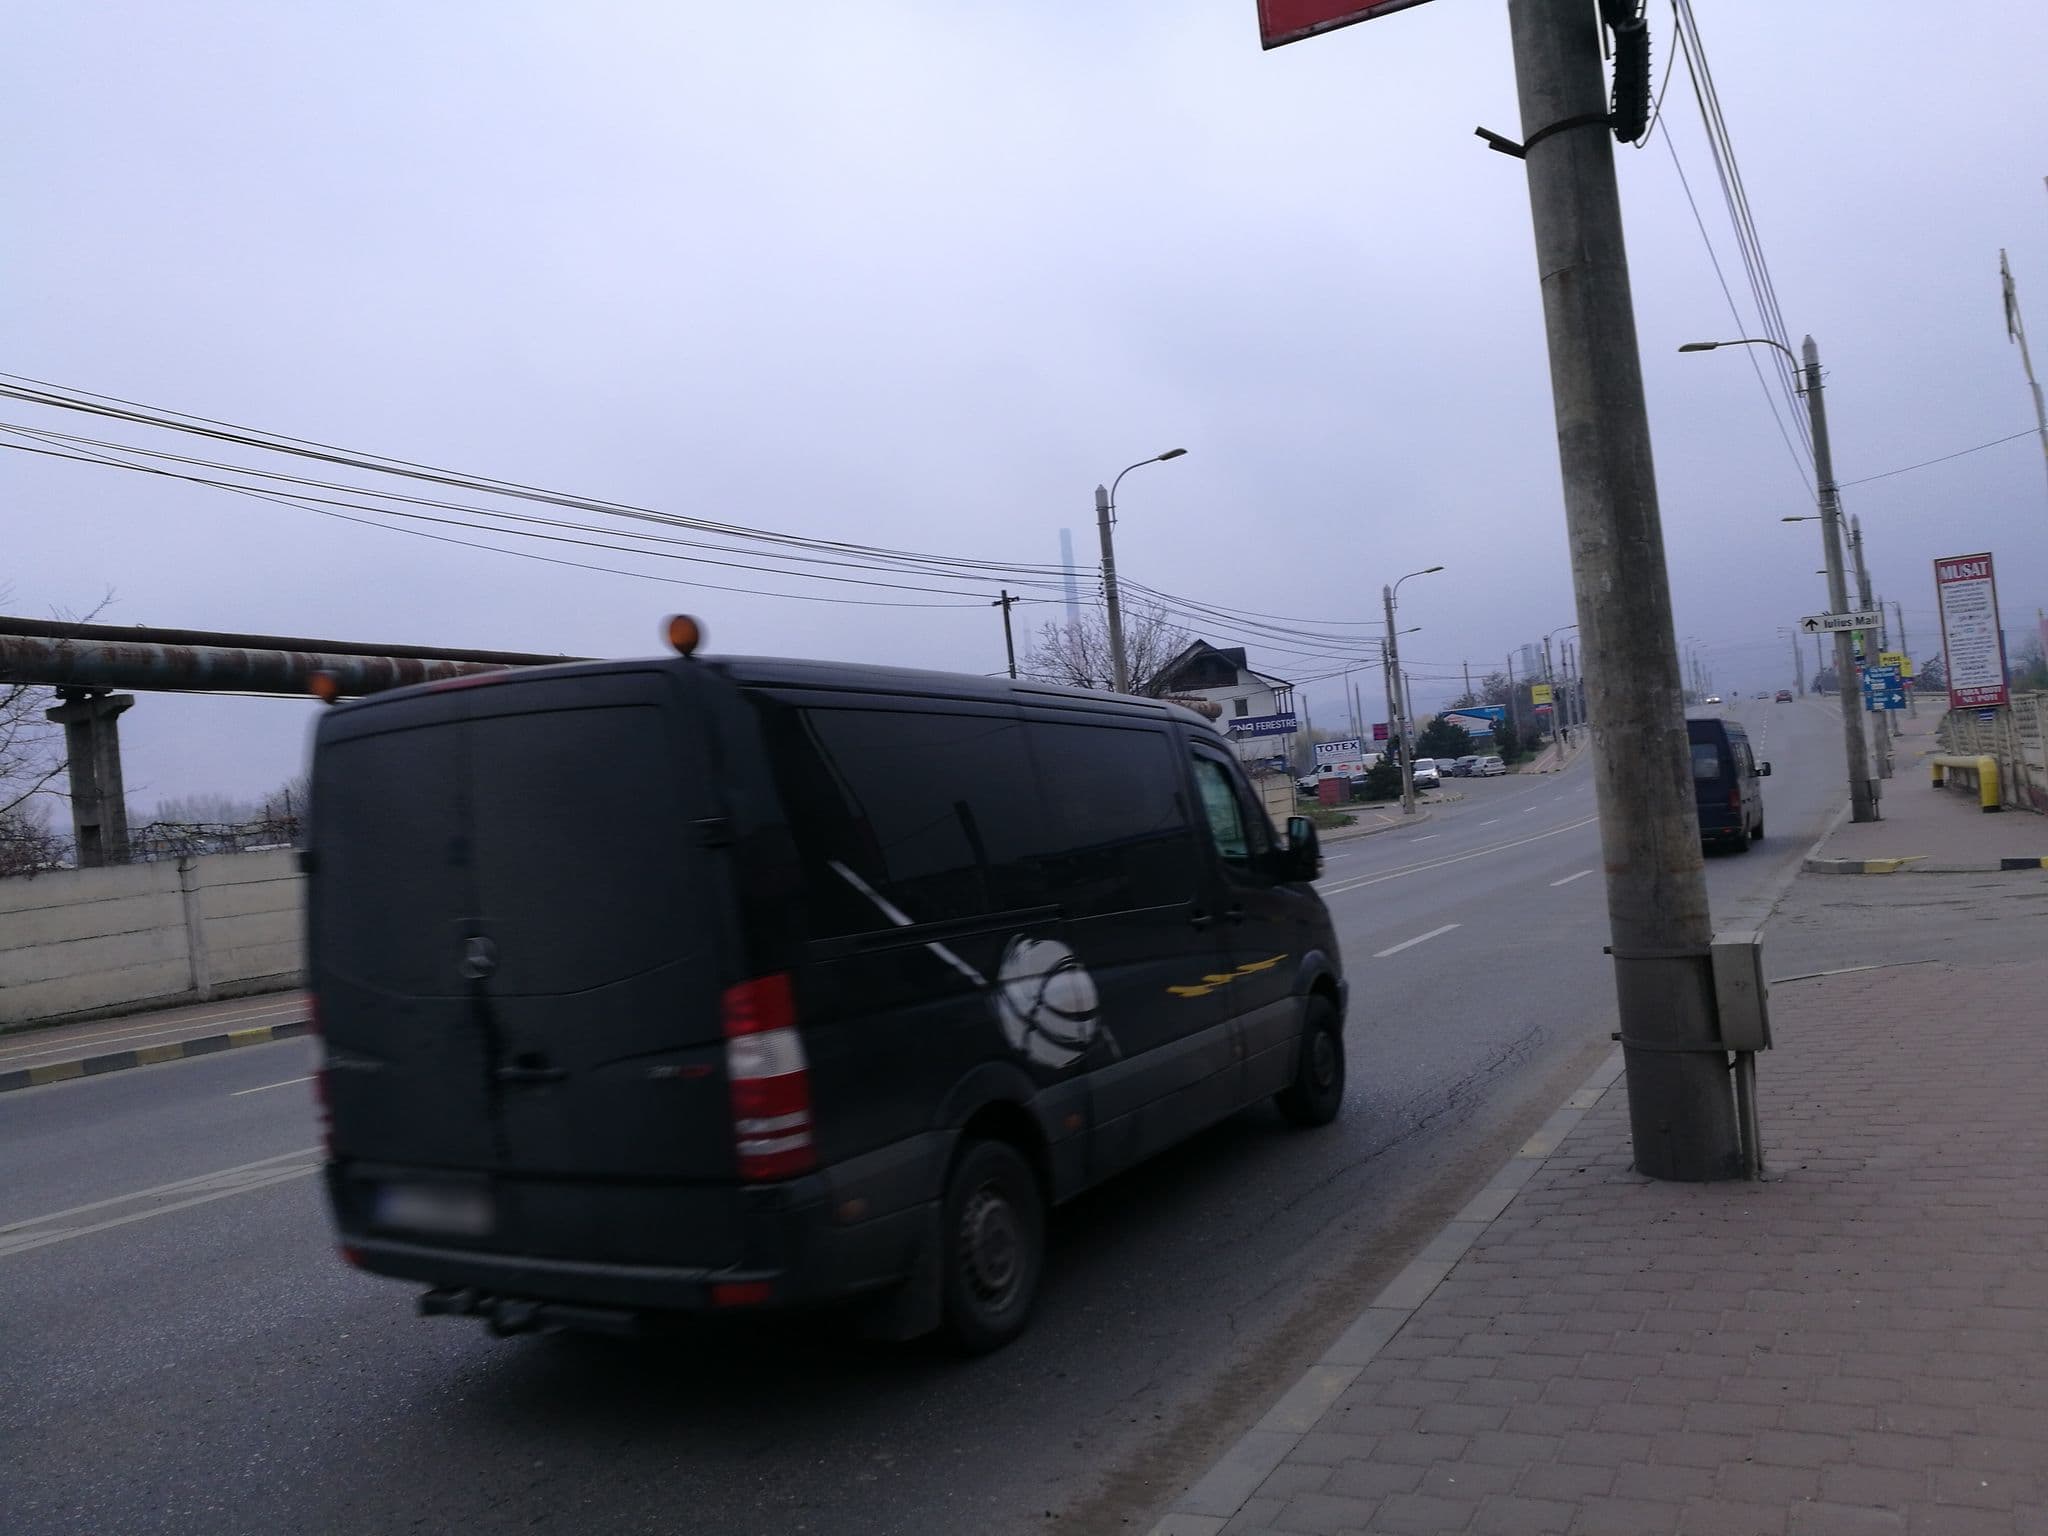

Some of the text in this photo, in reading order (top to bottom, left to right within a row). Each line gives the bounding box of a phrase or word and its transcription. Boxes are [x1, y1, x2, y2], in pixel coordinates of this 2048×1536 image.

[1824, 615, 1878, 629] Iulius Mall
[1256, 718, 1297, 731] FERESTRE
[1317, 741, 1358, 753] TOTEX
